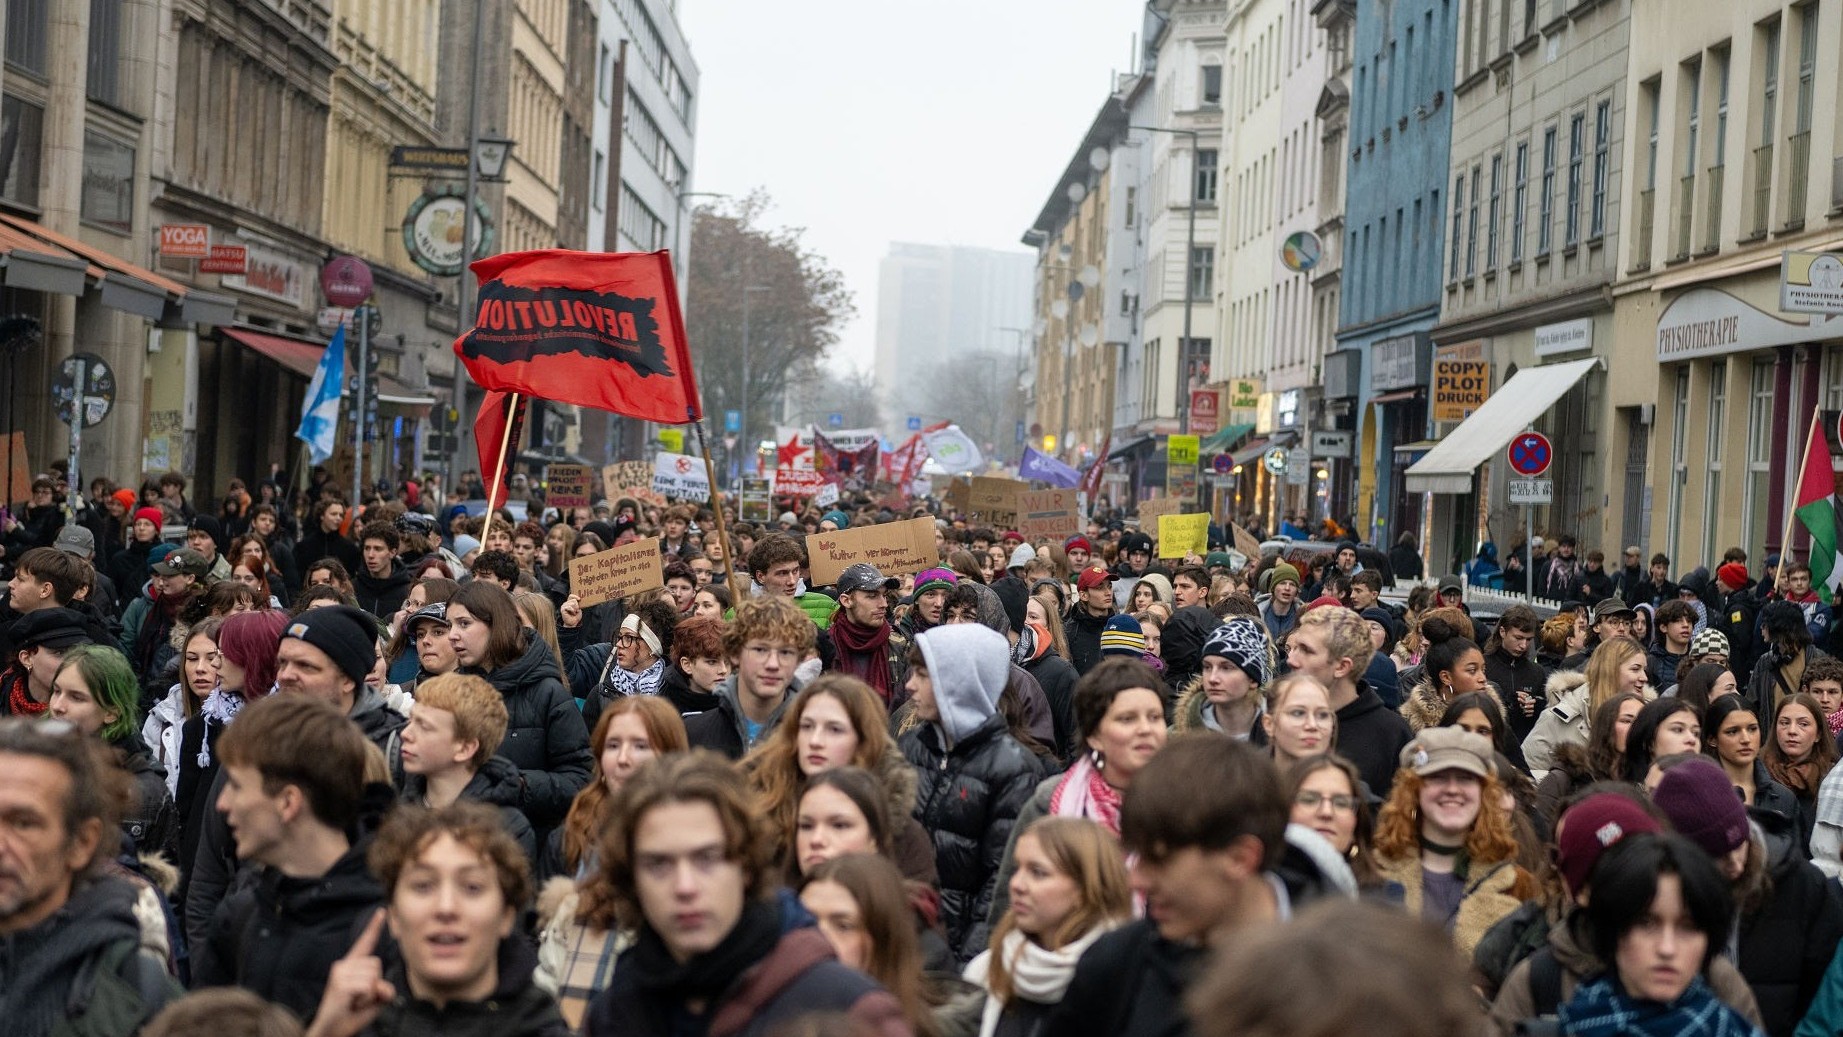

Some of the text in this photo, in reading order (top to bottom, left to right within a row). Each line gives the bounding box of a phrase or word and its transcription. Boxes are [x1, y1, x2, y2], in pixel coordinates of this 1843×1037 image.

[163, 227, 205, 244] YOGA
[1659, 315, 1739, 354] PHYSIOTHERAPIE
[1438, 362, 1485, 375] COPY
[1238, 381, 1253, 394] Bio
[1437, 377, 1484, 390] PLOT
[1437, 391, 1483, 404] DRUCK
[551, 485, 583, 495] KEINE
[1022, 493, 1063, 511] WIR
[829, 549, 858, 560] Kultur
